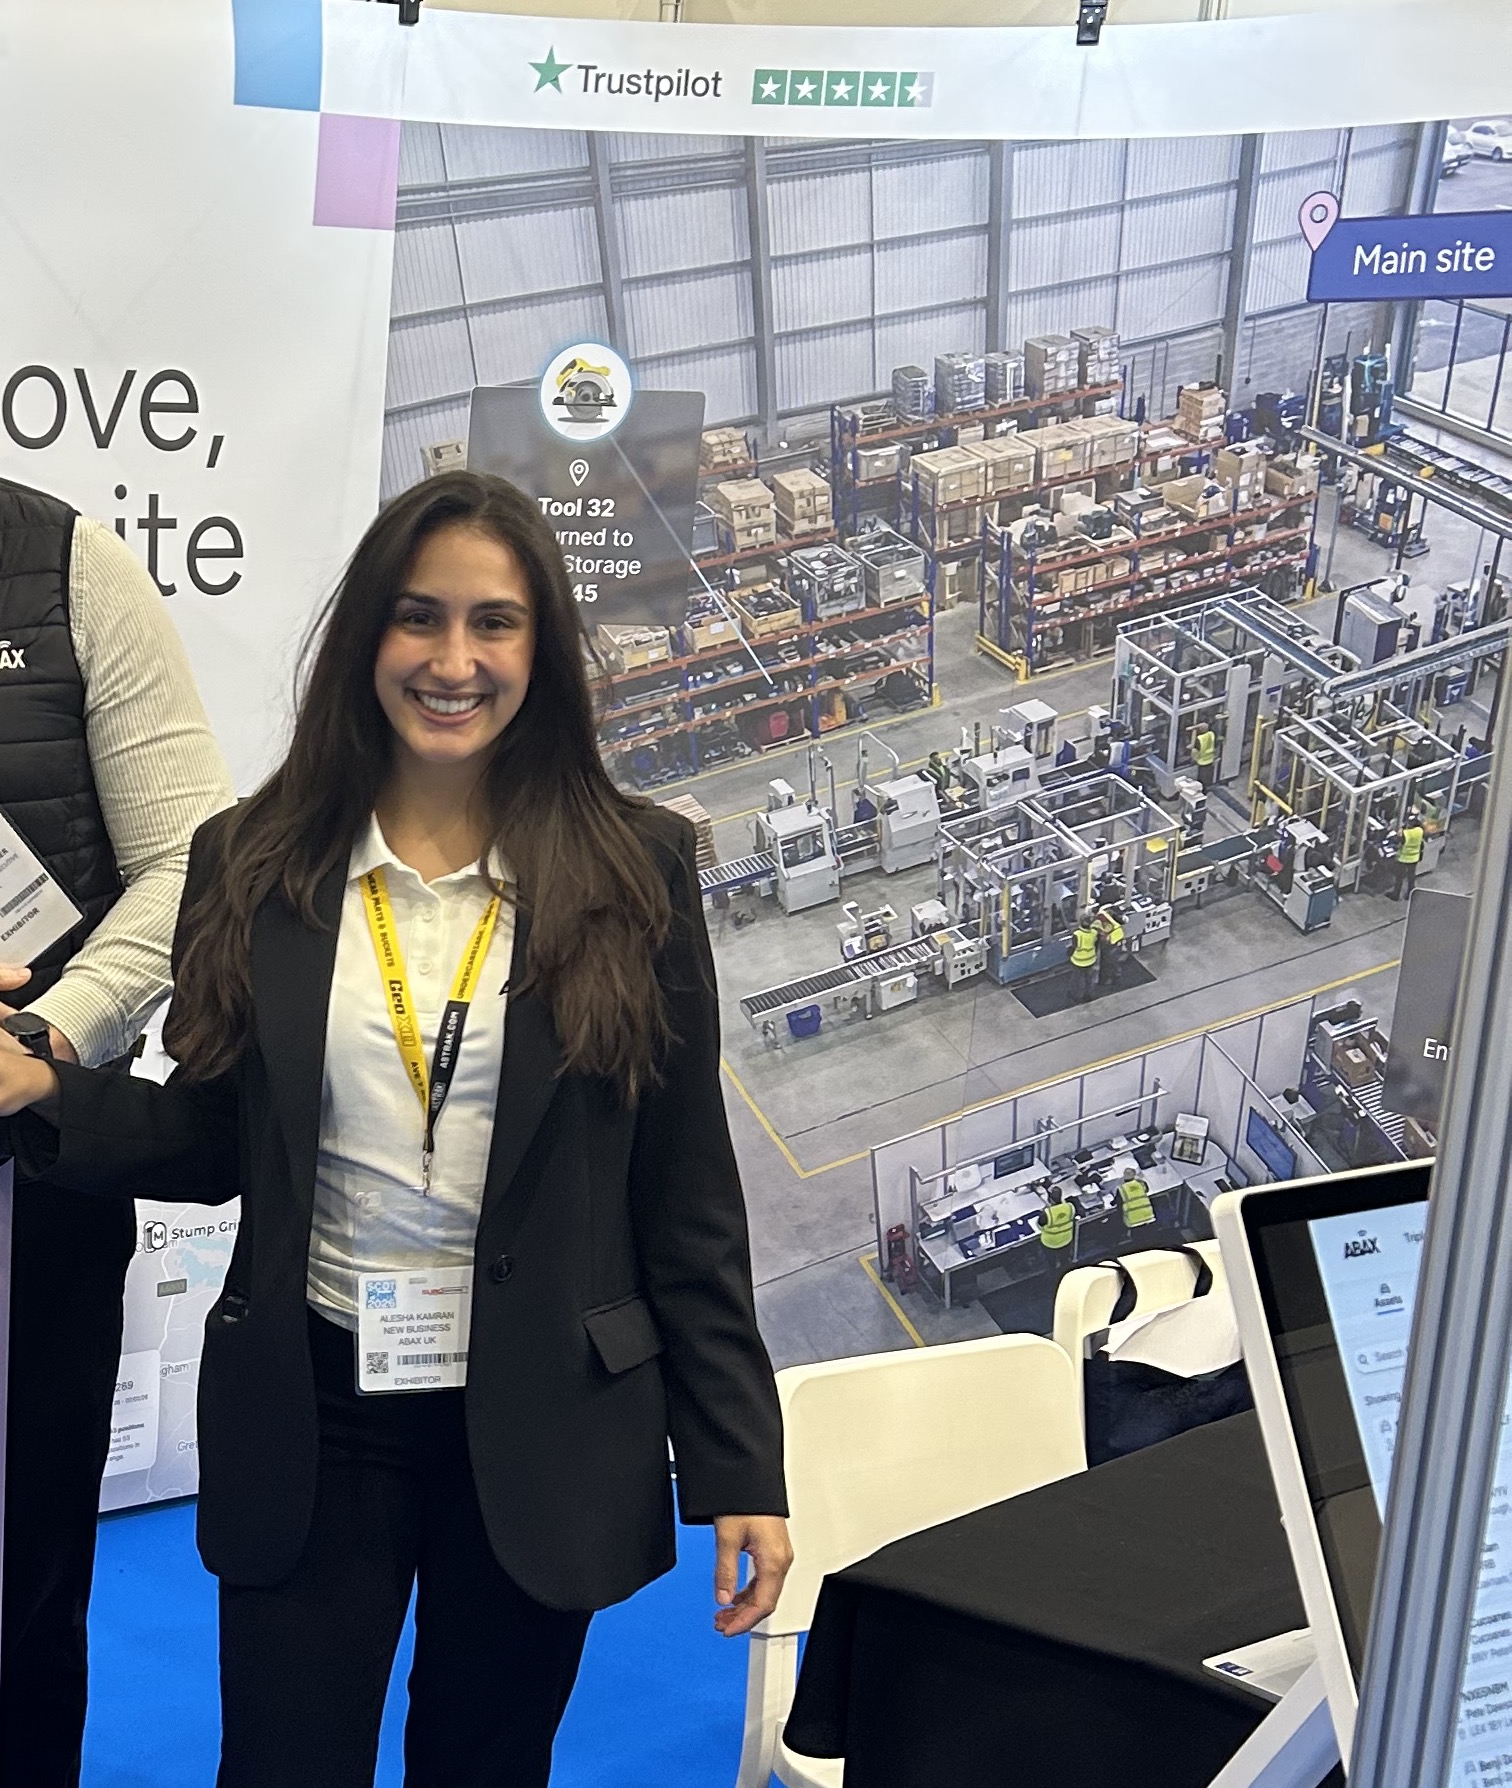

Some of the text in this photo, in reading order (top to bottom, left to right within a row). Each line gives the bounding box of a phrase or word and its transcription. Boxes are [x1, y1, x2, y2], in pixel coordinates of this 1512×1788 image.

[576, 64, 723, 103] Trustpilot
[1353, 240, 1495, 276] Main site
[538, 497, 615, 518] Tool 32
[613, 529, 634, 547] to
[563, 554, 642, 579] Storage
[0, 907, 40, 941] EXHIBITOR
[1423, 1037, 1448, 1061] En
[171, 1225, 215, 1239] Stump
[1344, 1237, 1381, 1259] ABAX
[366, 1281, 396, 1291] SCOT
[367, 1300, 396, 1309] 2026
[380, 1312, 455, 1323] ALESHA KAMRAN
[383, 1323, 451, 1335] NEW BUSINESS
[398, 1336, 437, 1345] ABAX UK
[160, 1363, 189, 1377] gham
[394, 1375, 441, 1385] EXHIBITOR
